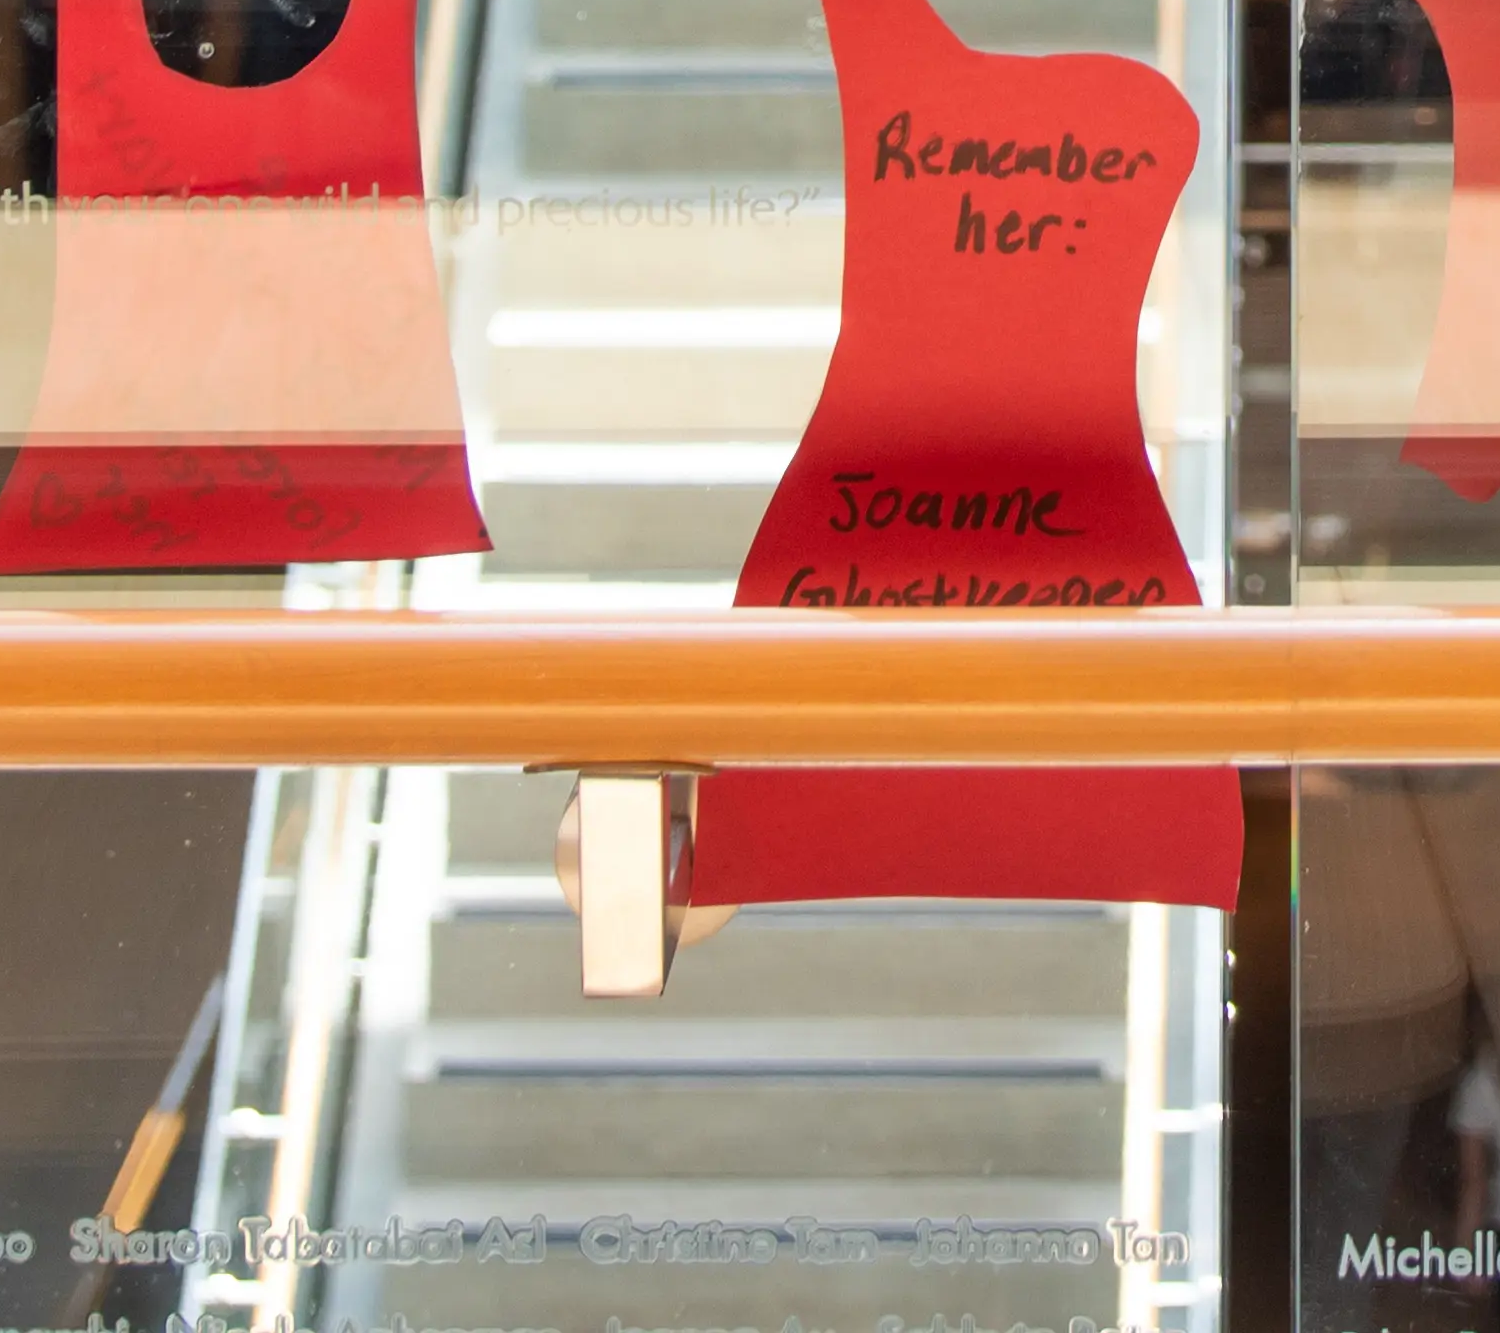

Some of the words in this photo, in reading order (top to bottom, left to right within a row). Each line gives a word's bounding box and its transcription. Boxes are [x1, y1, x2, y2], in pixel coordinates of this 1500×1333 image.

[873, 111, 1157, 183] Remember
[285, 182, 380, 227] wild
[394, 182, 480, 227] and
[498, 186, 695, 235] precious
[828, 472, 1088, 536] Joanne
[70, 1215, 232, 1266] Sharon
[579, 1214, 779, 1265] Christine
[785, 1215, 878, 1265] Tam
[908, 1214, 1100, 1268] Johanna
[1106, 1217, 1190, 1265] Tan
